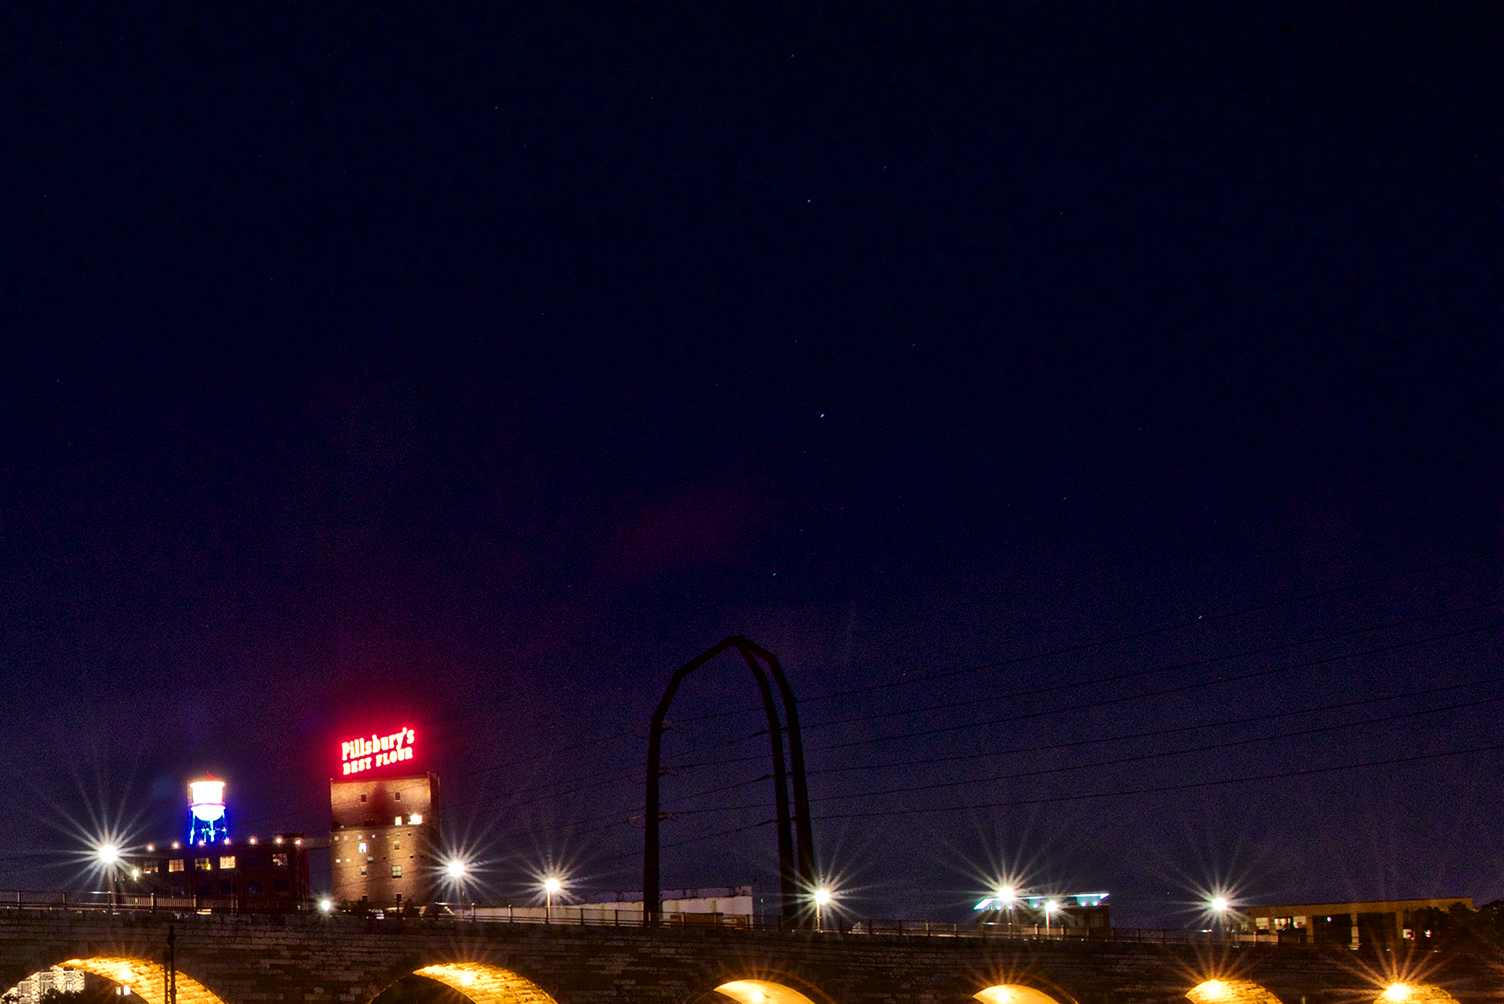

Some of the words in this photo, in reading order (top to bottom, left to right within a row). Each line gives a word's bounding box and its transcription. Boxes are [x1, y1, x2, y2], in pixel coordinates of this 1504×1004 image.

[342, 727, 415, 761] Pillsbury's
[343, 757, 372, 775] BEST
[375, 746, 413, 767] FLOUR
